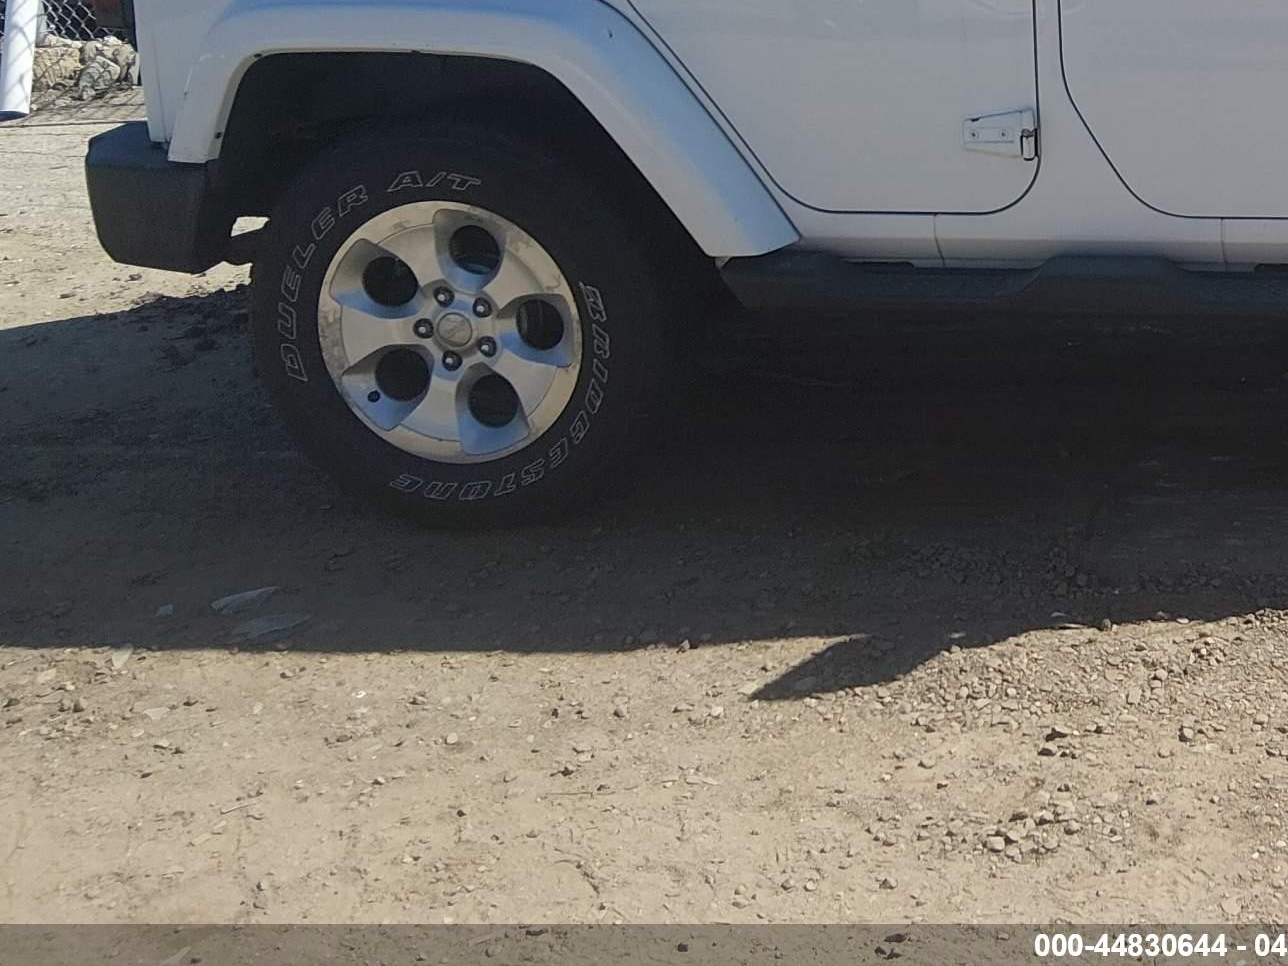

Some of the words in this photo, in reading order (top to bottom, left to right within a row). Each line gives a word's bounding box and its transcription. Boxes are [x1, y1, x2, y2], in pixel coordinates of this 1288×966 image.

[276, 184, 369, 382] DUELER
[386, 170, 482, 192] A/T
[389, 280, 611, 501] BRIDGESTONE
